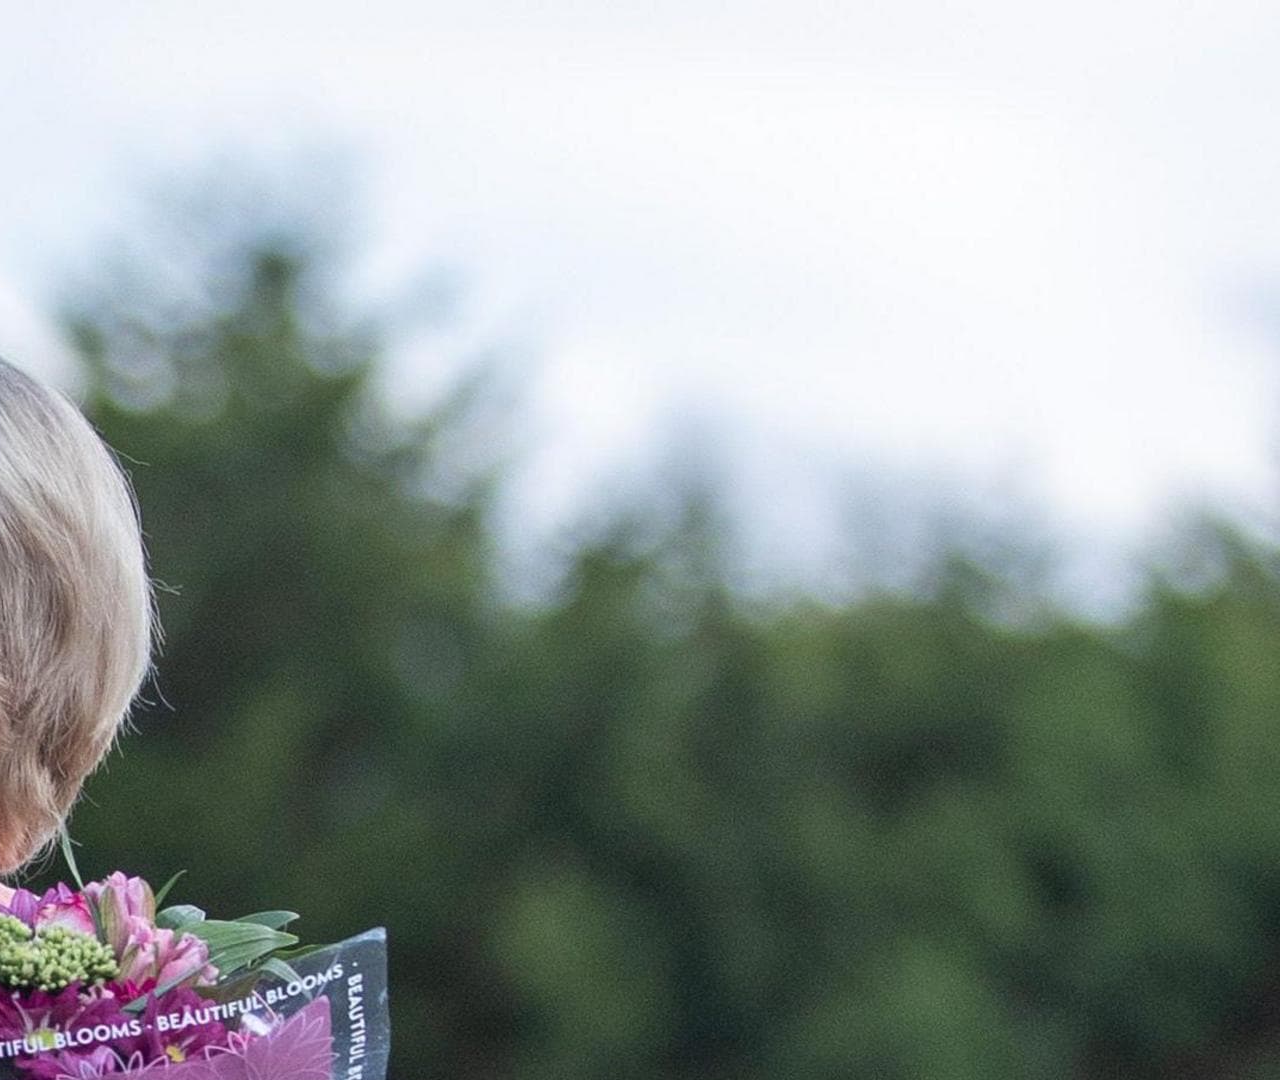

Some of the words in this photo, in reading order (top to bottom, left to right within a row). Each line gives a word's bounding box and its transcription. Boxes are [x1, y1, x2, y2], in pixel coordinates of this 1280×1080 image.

[53, 1019, 142, 1049] BLOOMS
[156, 999, 266, 1032] BEAUTIFUL
[266, 963, 344, 1004] BLOOMS
[346, 972, 366, 1064] BEAUTIFUL
